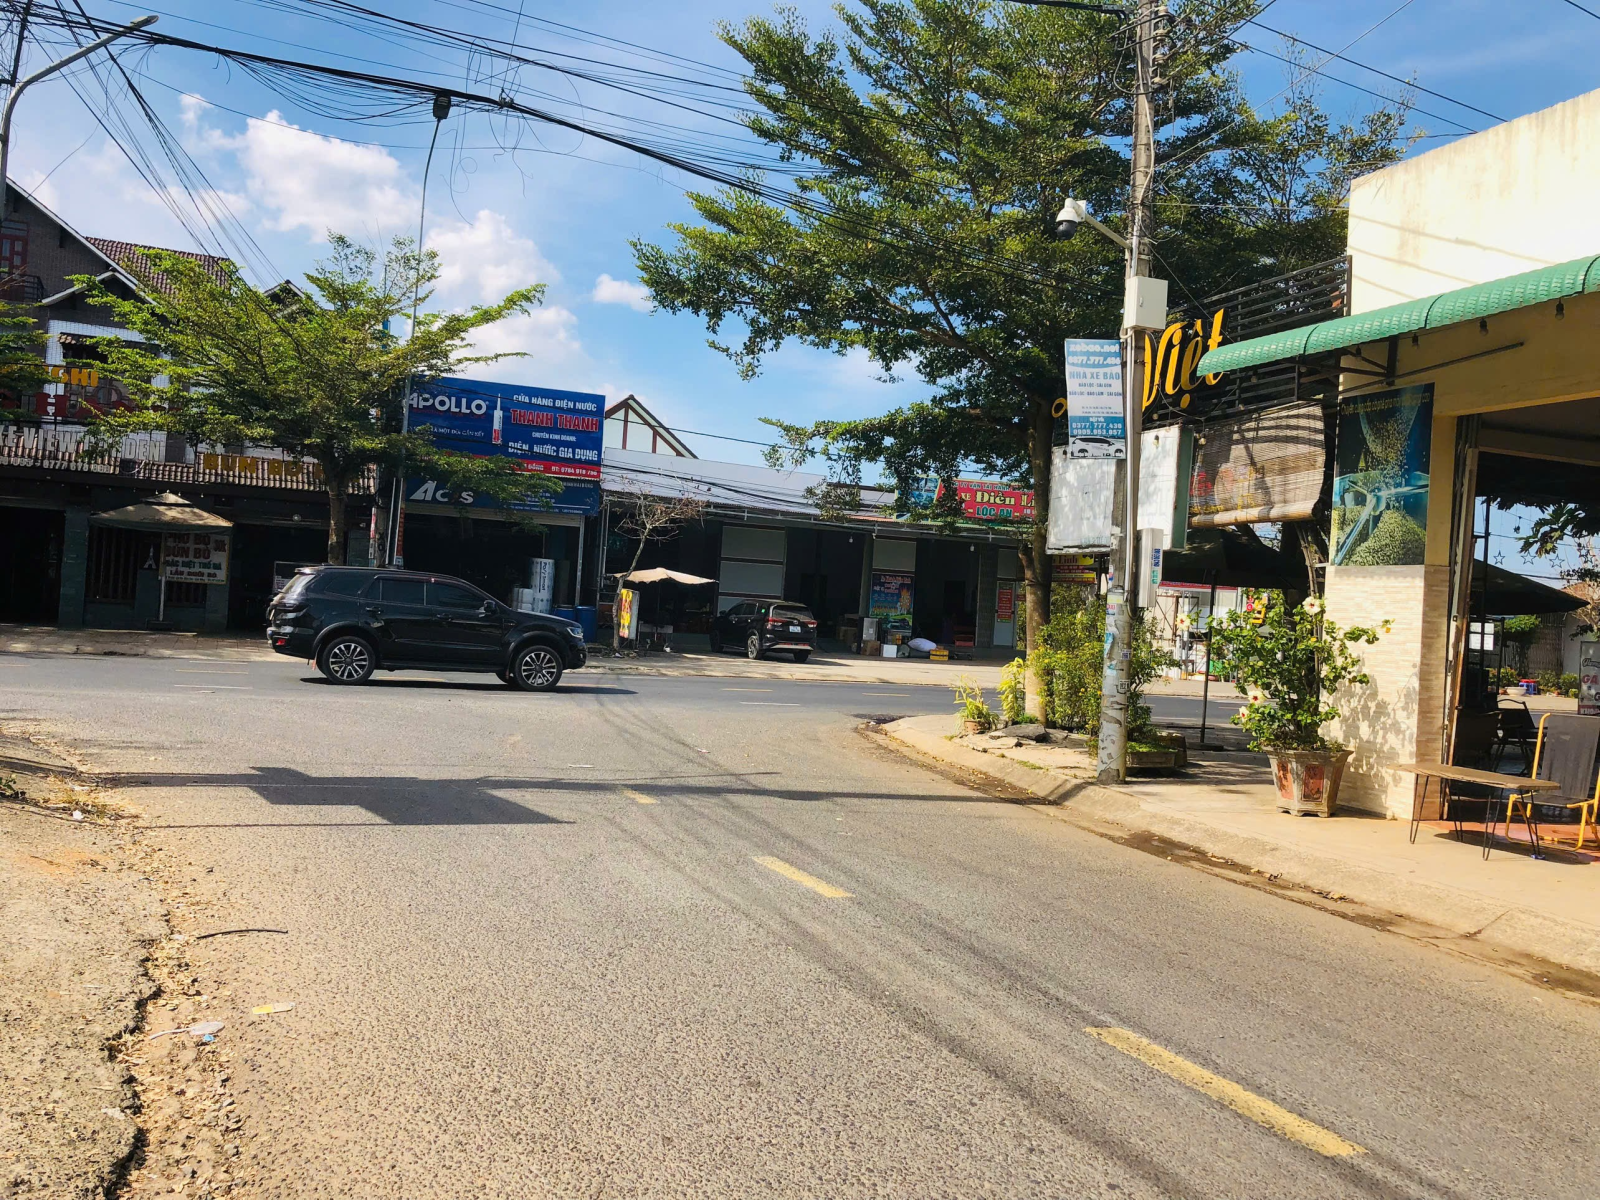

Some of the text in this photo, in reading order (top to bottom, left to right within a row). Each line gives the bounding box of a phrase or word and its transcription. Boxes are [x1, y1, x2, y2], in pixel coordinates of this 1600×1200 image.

[1069, 343, 1119, 352] xebao.net
[1142, 308, 1224, 412] Việt
[1090, 372, 1100, 380] XE
[408, 393, 487, 415] APOLLO
[513, 393, 597, 411] CỬA HÀNG ĐIỆN NƯỚC
[510, 409, 599, 432] THANH THANH
[23, 427, 77, 453] VIEW
[558, 447, 573, 459] GIA
[575, 448, 598, 461] DỤNG
[961, 492, 971, 500] XE
[1021, 493, 1035, 507] Li
[976, 505, 995, 519] LỘC
[998, 508, 1013, 519] AN
